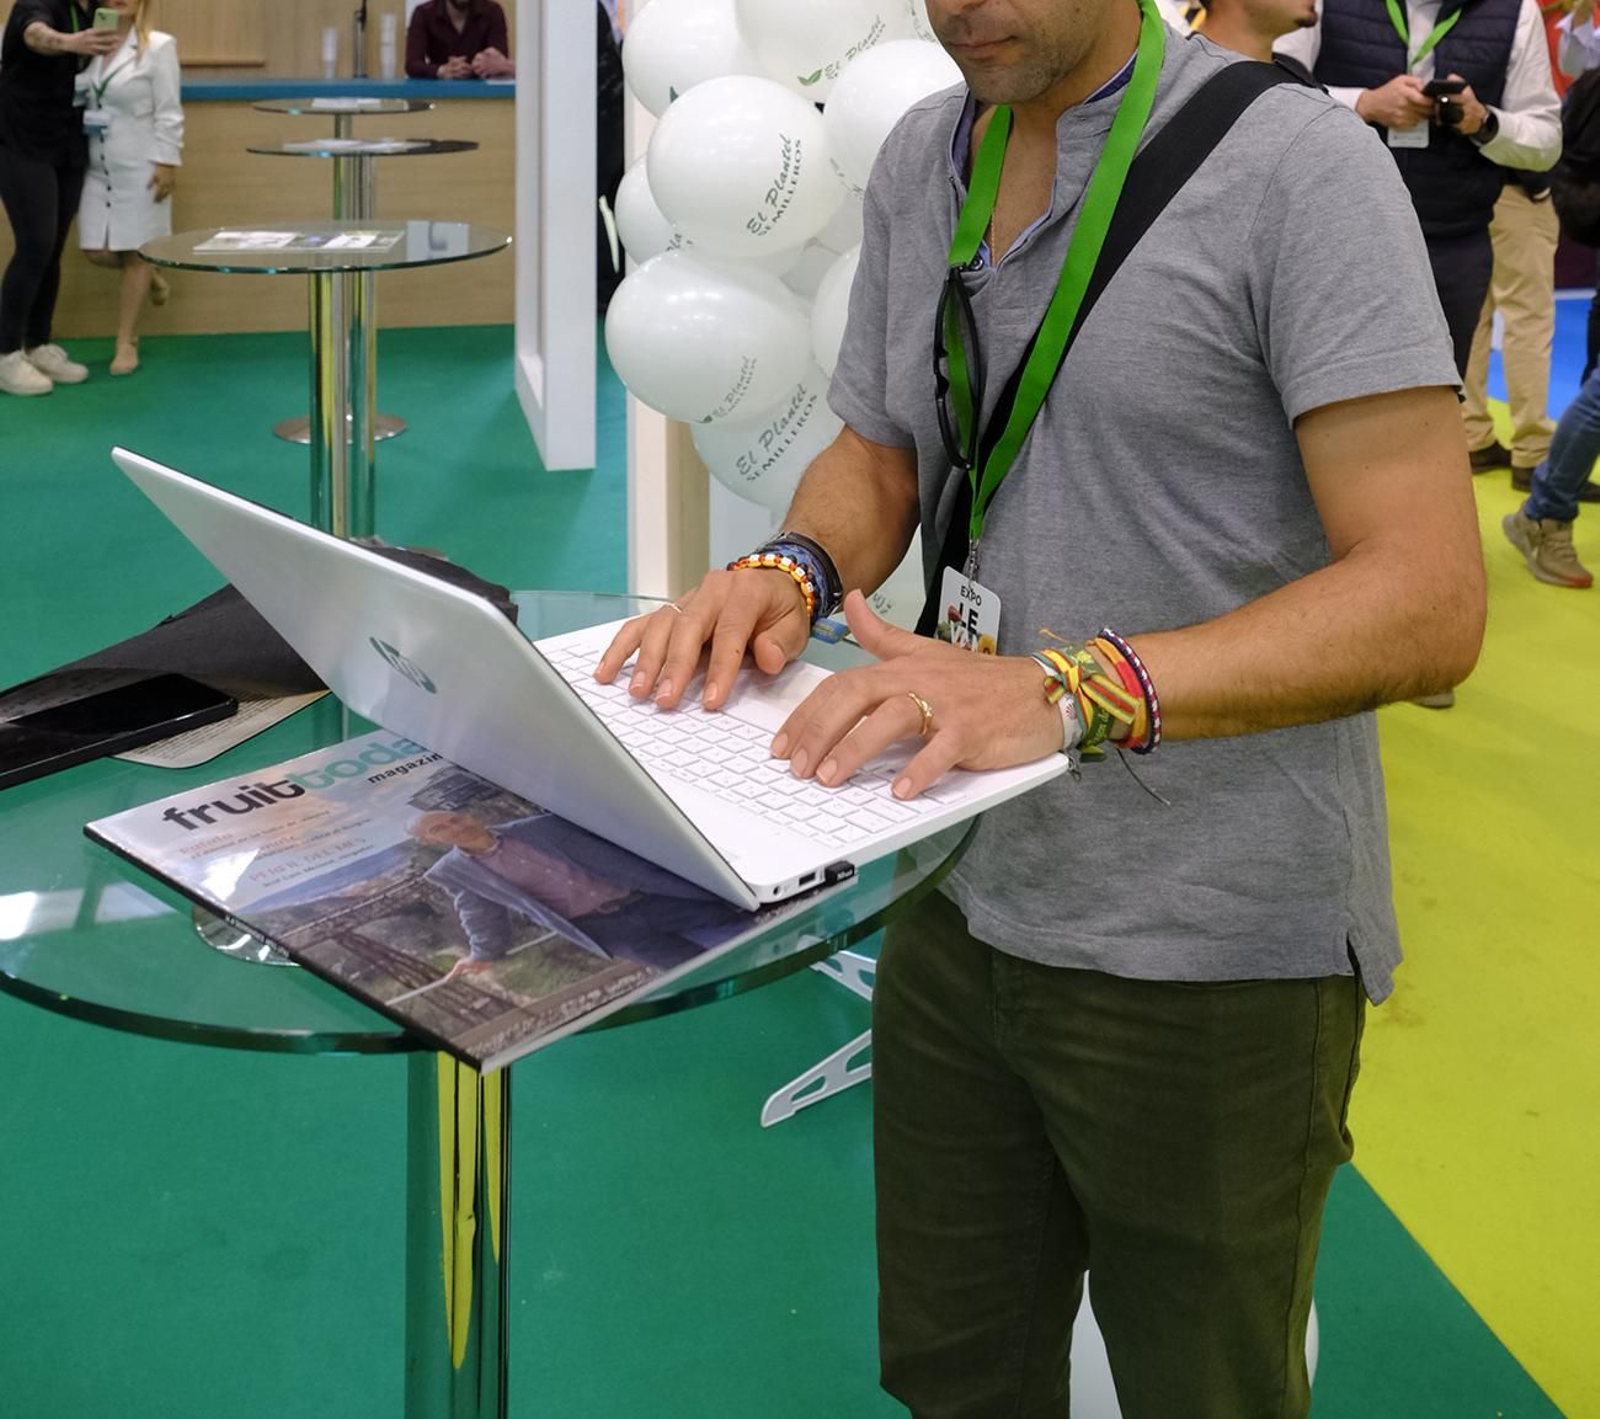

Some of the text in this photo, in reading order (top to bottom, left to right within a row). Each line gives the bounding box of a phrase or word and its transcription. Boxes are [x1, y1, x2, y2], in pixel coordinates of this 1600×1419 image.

[764, 133, 791, 208] Plantel
[758, 383, 807, 453] Plantel
[960, 584, 983, 607] EXPO
[161, 735, 429, 831] fruittoda
[367, 752, 444, 784] magazin
